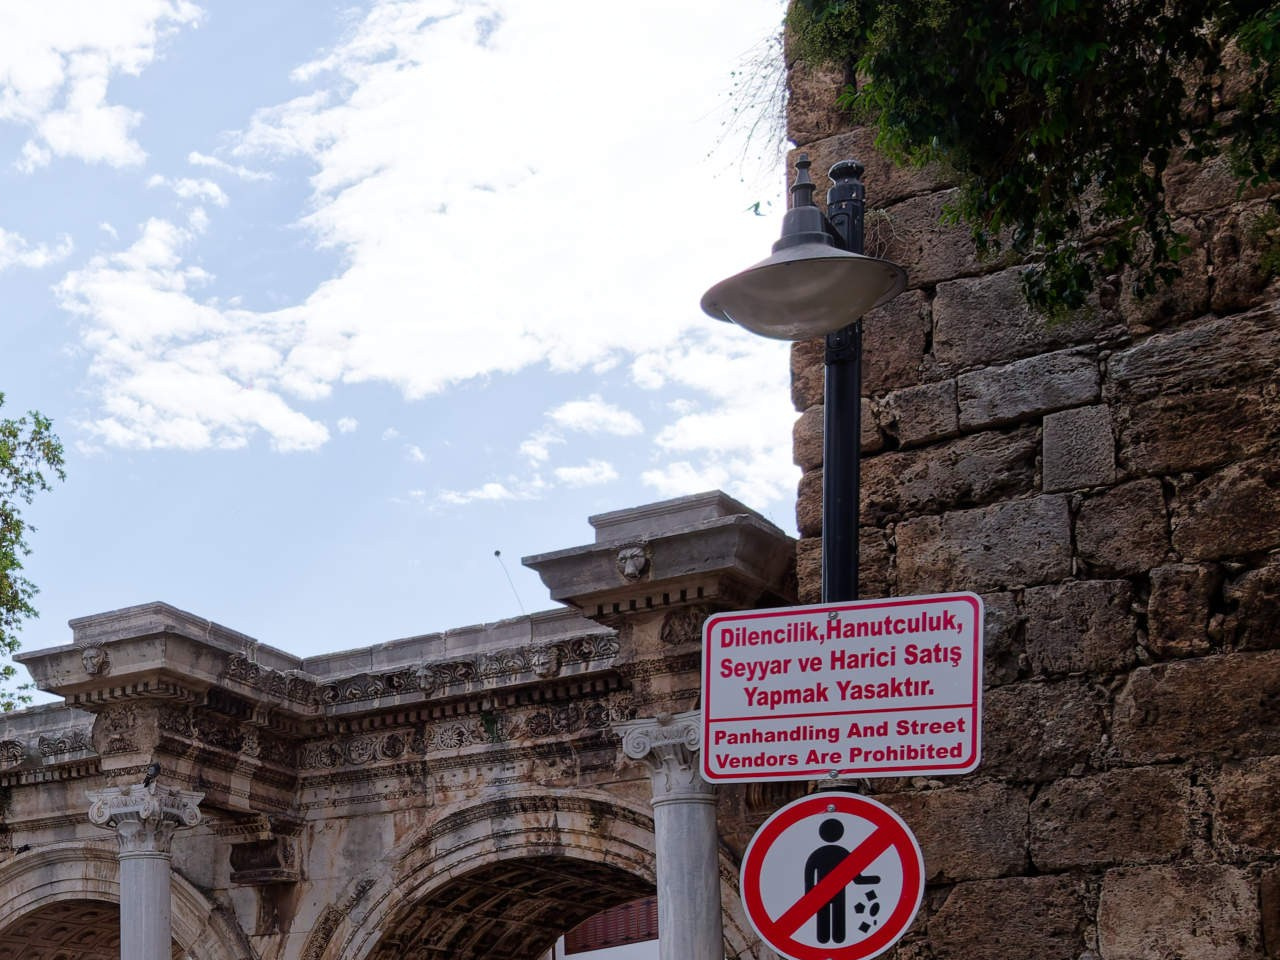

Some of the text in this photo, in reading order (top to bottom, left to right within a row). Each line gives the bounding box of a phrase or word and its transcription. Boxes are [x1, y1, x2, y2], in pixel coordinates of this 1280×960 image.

[721, 643, 962, 682] Seyyar ve Harici Satış
[743, 676, 935, 711] Yapmak Yasaktır.
[714, 717, 966, 746] Panhandling And Street
[715, 741, 963, 769] Vendors Are Prohibited
